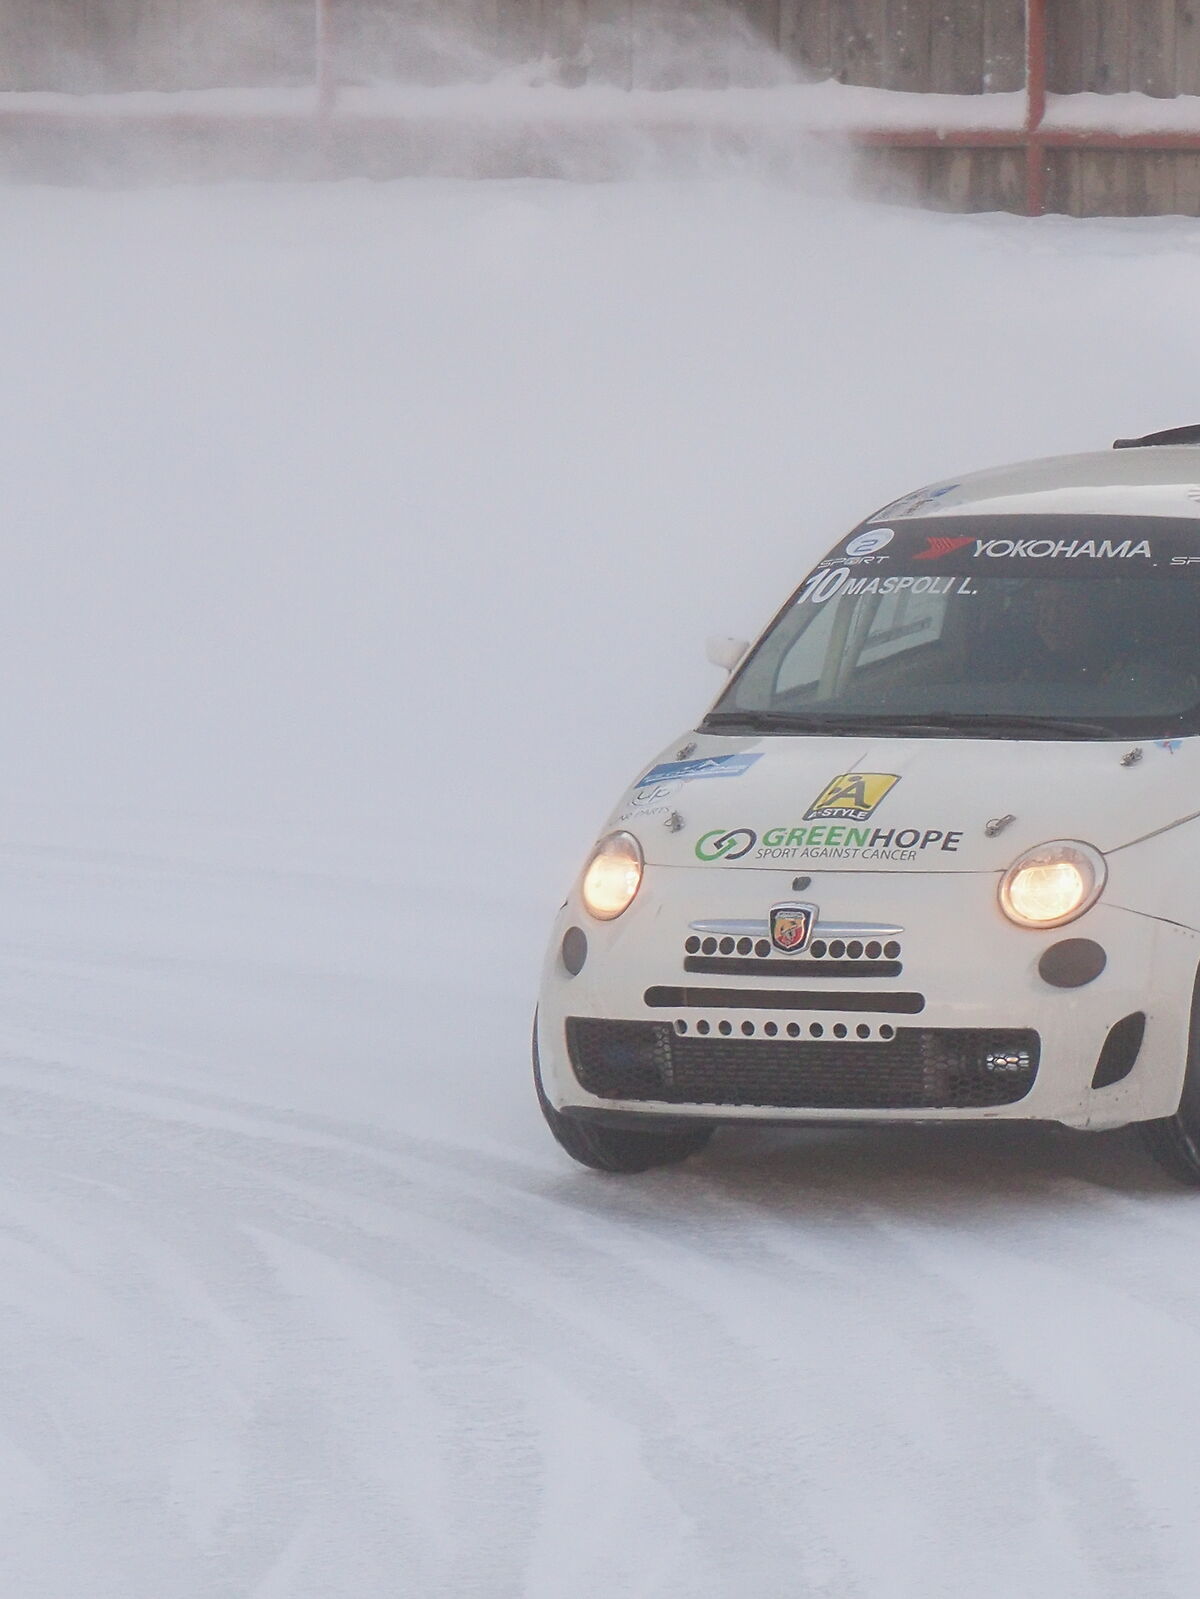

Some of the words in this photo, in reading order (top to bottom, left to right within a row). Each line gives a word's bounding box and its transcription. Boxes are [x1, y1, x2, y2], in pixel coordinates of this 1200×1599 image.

[971, 538, 1154, 560] YOKOHAMA
[817, 555, 890, 570] SPORT
[797, 566, 851, 605] 10
[842, 576, 957, 596] MASPOLI
[956, 576, 978, 596] L.
[807, 808, 869, 820] A-STYLE
[761, 825, 964, 852] GREENHOPE
[755, 847, 799, 860] SPORT
[800, 846, 861, 860] AGAINST
[861, 848, 917, 862] CANCER
